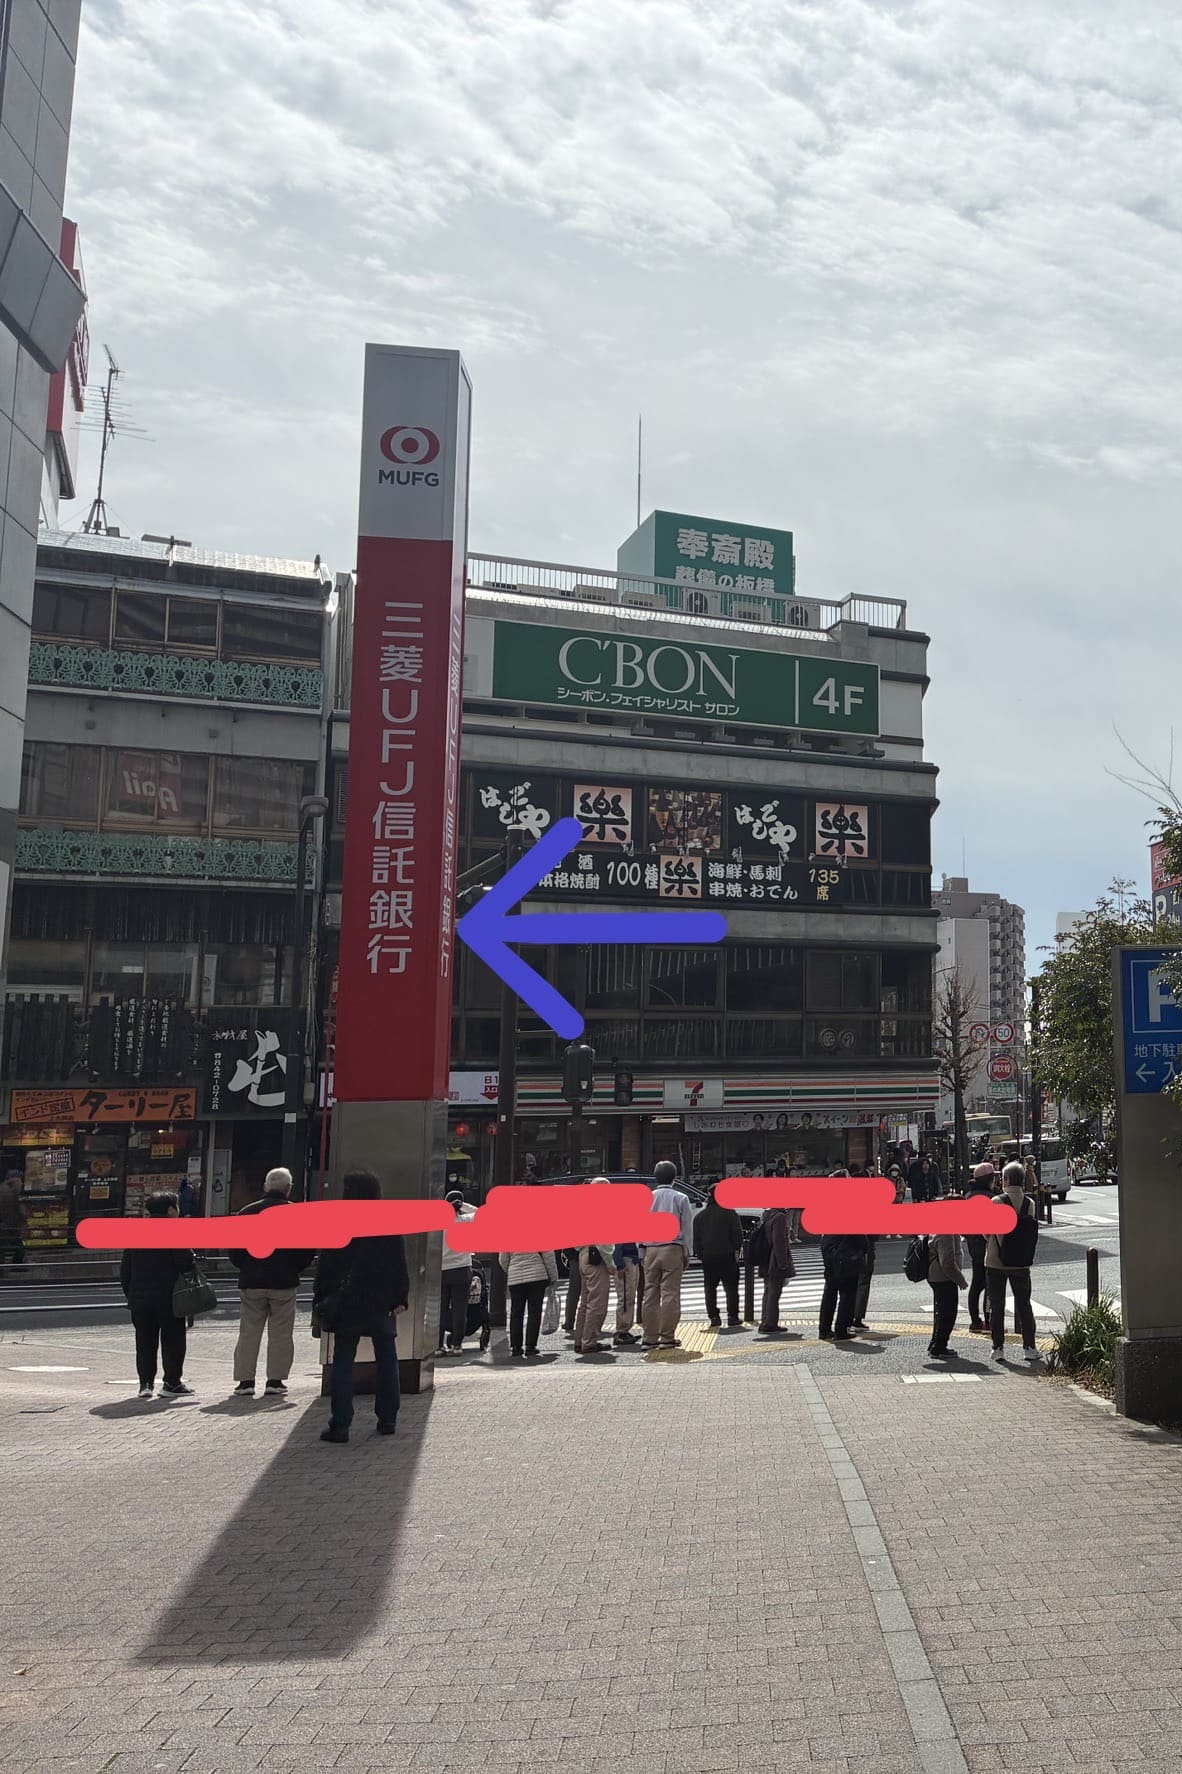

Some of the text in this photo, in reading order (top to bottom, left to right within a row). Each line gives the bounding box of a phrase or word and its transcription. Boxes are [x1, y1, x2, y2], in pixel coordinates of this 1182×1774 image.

[378, 469, 439, 487] MUFG
[677, 527, 775, 572] 奉斎殿
[557, 635, 740, 699] C'BON
[705, 701, 740, 716] サロン
[812, 677, 866, 716] 4F
[366, 601, 424, 975] 三菱UFJ信託銀行
[809, 868, 840, 884] 135
[817, 885, 830, 901] 席
[998, 1027, 1010, 1038] 50
[79, 1090, 193, 1119] ターリー屋
[685, 1081, 704, 1106] 7
